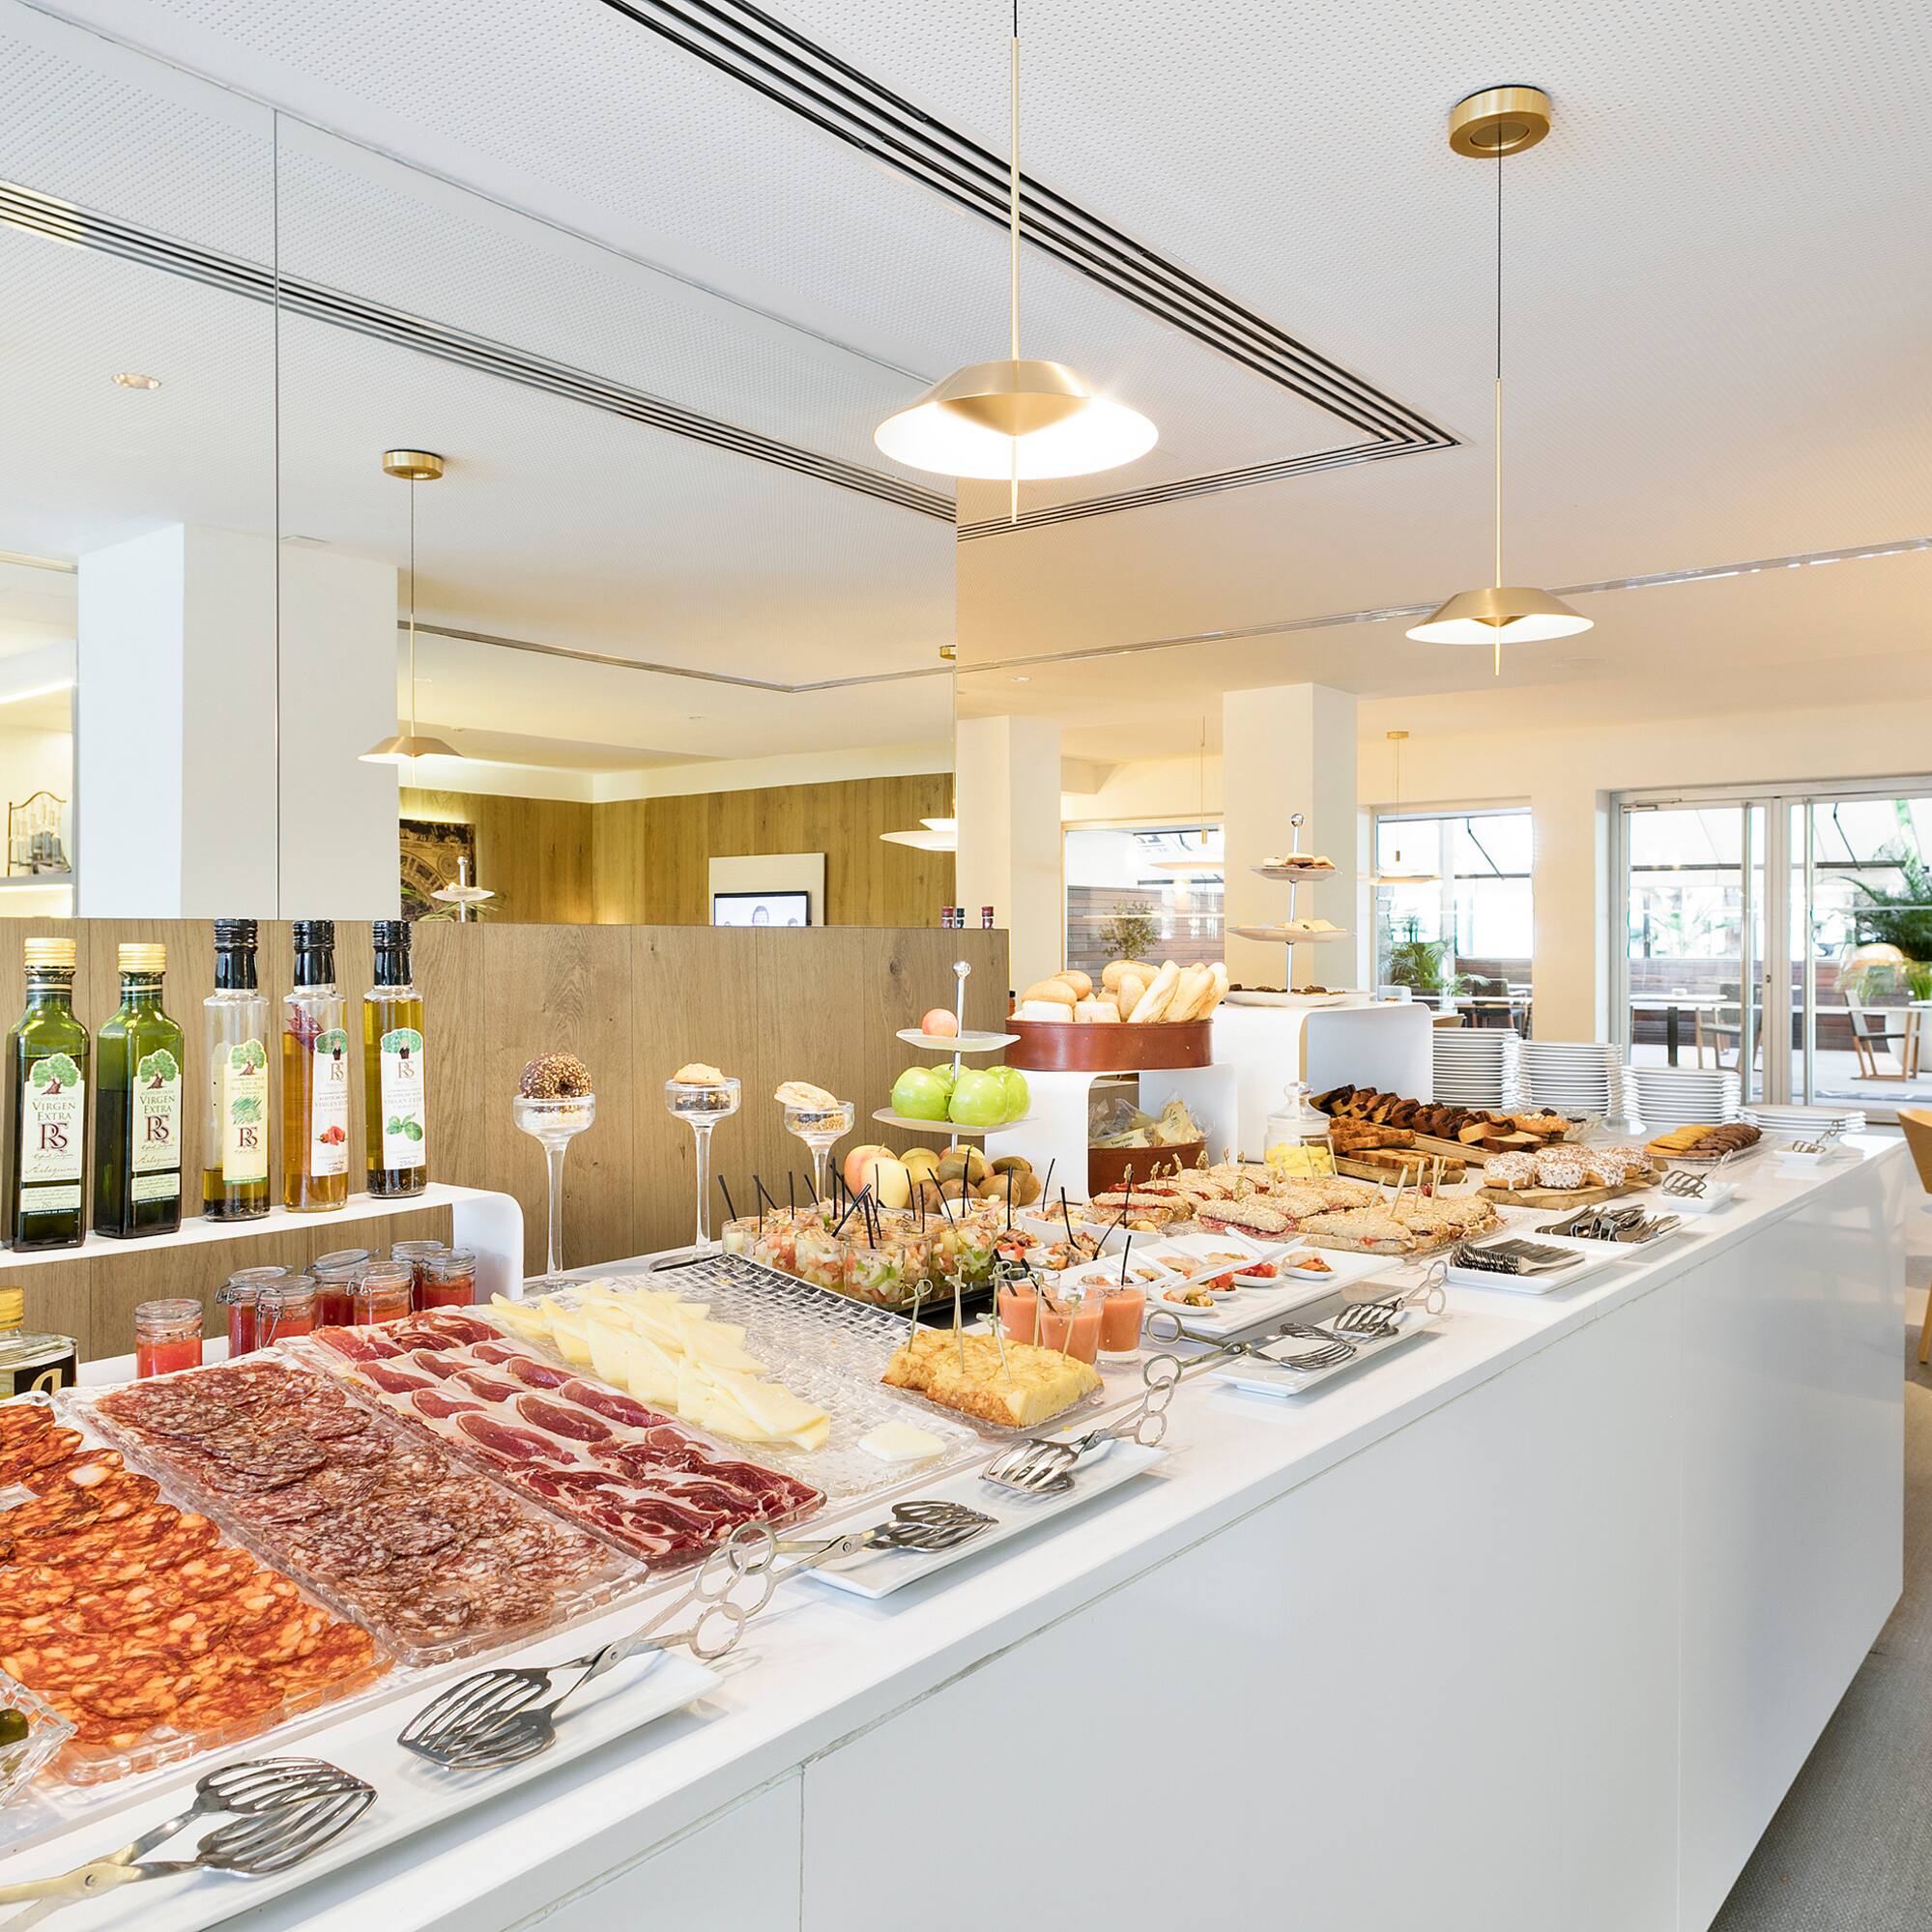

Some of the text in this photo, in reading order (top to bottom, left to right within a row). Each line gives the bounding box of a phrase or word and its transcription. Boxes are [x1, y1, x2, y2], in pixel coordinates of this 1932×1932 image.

[139, 1095, 176, 1105] VIRGEN
[32, 1101, 76, 1111] VIRGEN
[144, 1105, 172, 1114] EXTRA
[37, 1111, 72, 1122] EXTRA
